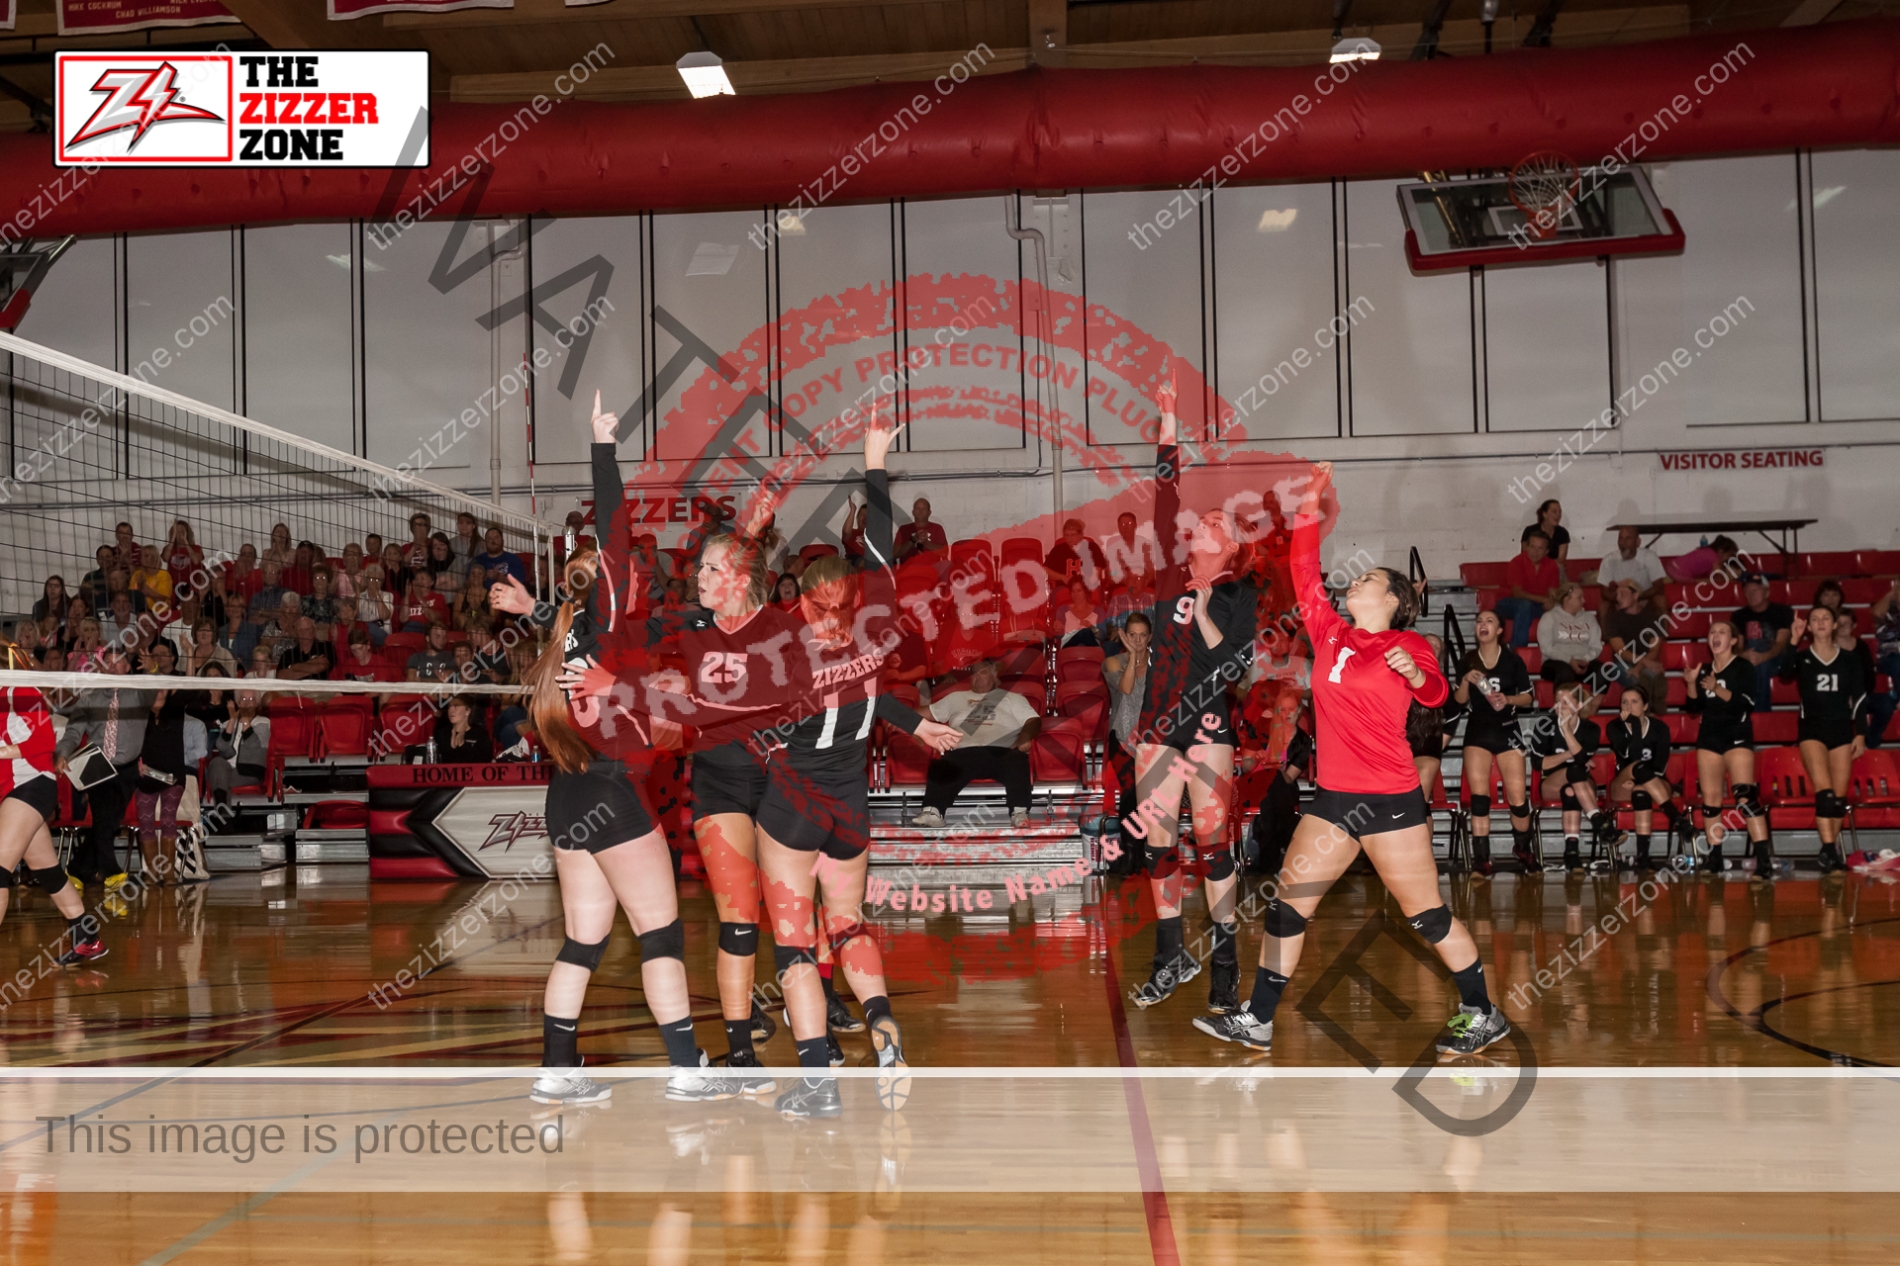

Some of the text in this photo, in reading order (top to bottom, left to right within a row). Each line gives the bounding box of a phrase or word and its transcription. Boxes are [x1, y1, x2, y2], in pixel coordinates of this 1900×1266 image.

[115, 6, 181, 19] CHAD WILLIAMSON
[1660, 450, 1824, 470] VISITOR SEATING
[701, 651, 748, 684] 25
[812, 647, 885, 689] ZIZZERS
[1328, 646, 1356, 684] 1
[1816, 674, 1839, 692] 21
[412, 764, 549, 783] HOME OF TH
